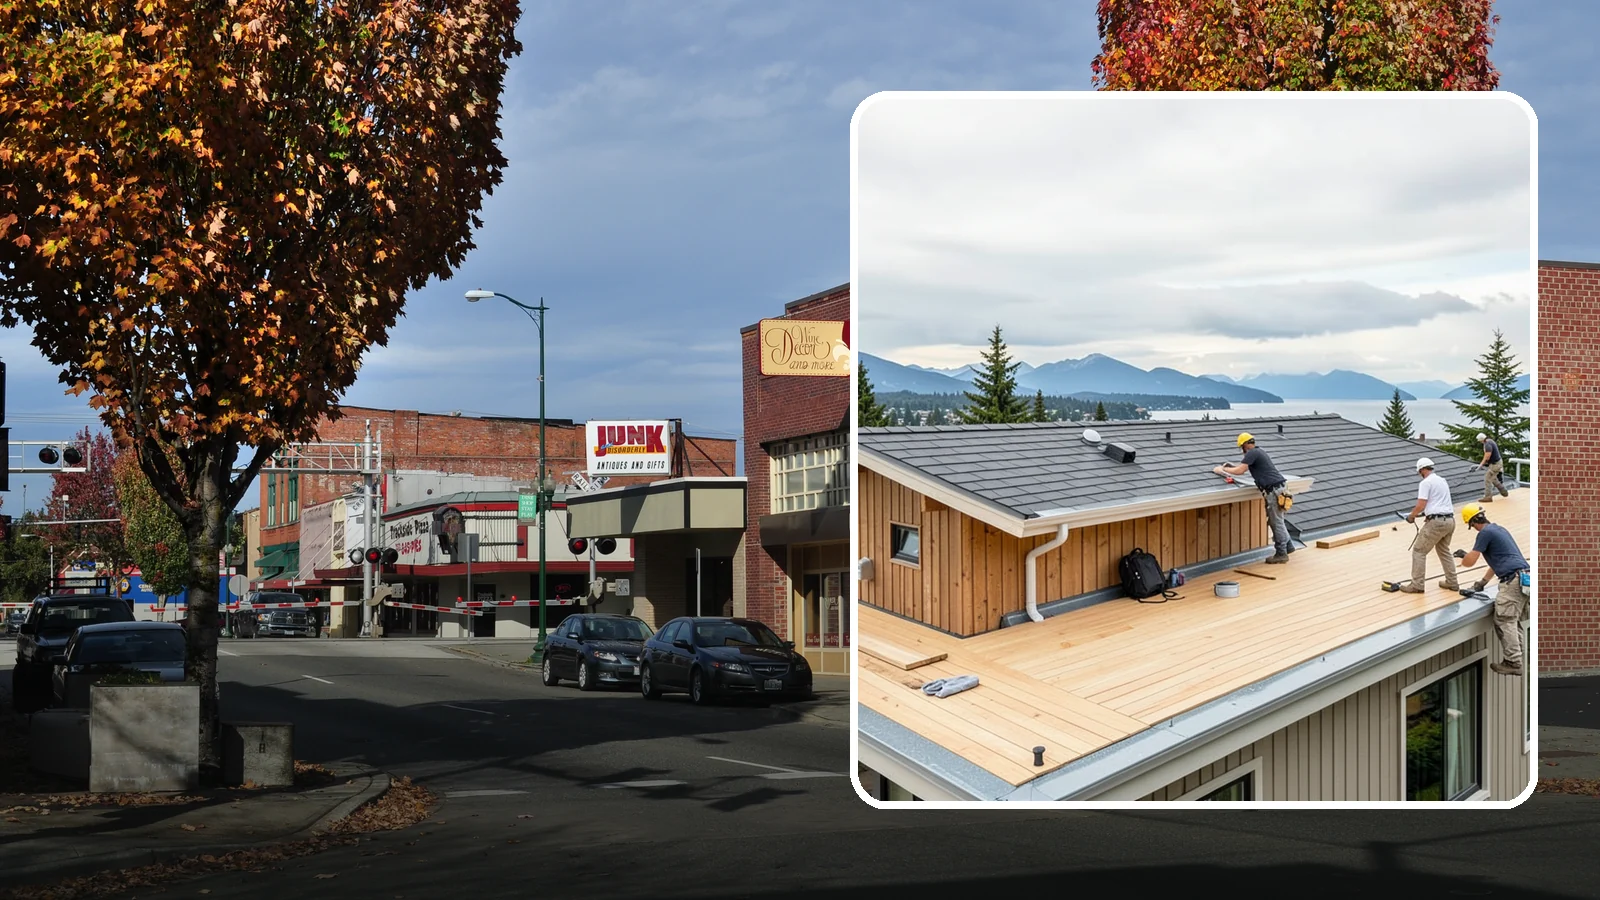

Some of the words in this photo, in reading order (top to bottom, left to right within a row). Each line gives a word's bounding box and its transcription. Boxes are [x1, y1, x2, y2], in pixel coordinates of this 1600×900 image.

[596, 425, 665, 457] JUNK
[608, 446, 646, 454] DISORDERLY
[597, 461, 628, 470] ANTIQUES
[631, 461, 644, 470] AND
[647, 461, 665, 469] GIFTS
[390, 521, 413, 540] Trackside
[414, 519, 429, 535] Pizza
